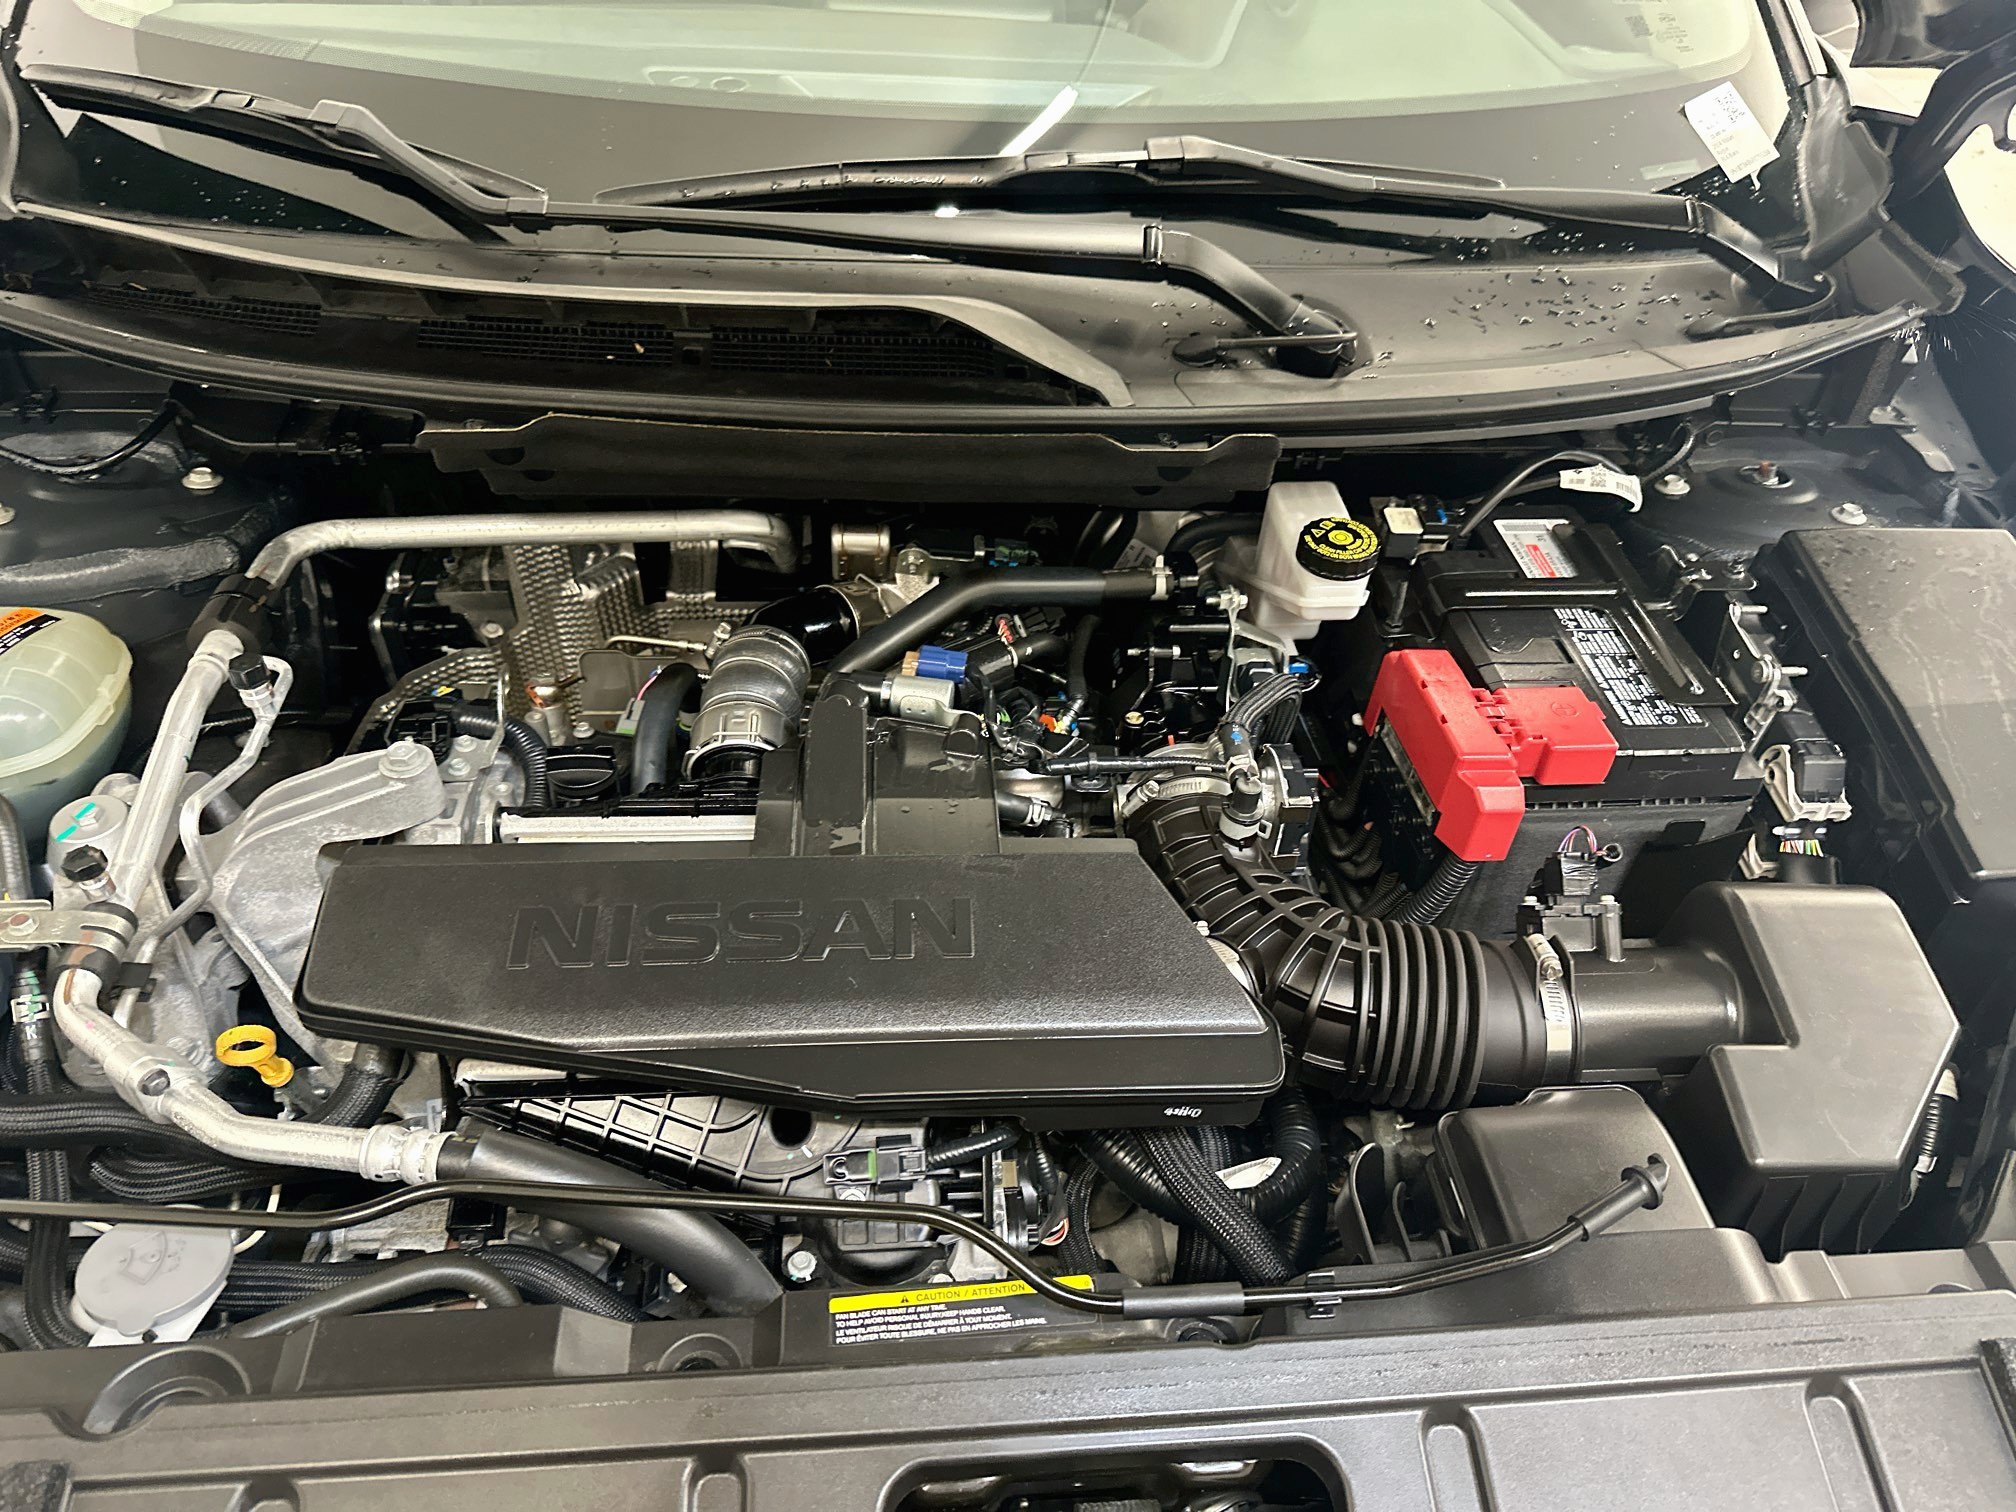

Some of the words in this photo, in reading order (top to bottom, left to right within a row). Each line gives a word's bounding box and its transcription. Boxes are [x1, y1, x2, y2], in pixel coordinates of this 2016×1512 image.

[506, 898, 975, 969] NISSAN
[25, 1025, 38, 1040] K
[916, 1291, 961, 1302] CAUTION
[971, 1284, 1026, 1297] ATTENTION
[846, 1319, 864, 1327] HELP
[864, 1317, 884, 1325] AVOID
[885, 1314, 919, 1323] PERSONAL
[959, 1307, 982, 1315] HANDS
[982, 1305, 1006, 1314] CLEAR.
[850, 1311, 871, 1319] BLADE
[887, 1307, 907, 1315] START
[930, 1303, 947, 1311] TIME.
[836, 1336, 856, 1344] POUR
[879, 1332, 901, 1340] TOUTE
[937, 1326, 947, 1334] NE
[947, 1325, 961, 1333] PAS
[971, 1321, 1012, 1331] APPROCHER
[1012, 1319, 1025, 1327] LES
[845, 1325, 887, 1335] VENTILATEUR
[887, 1323, 912, 1331] RISQUE
[913, 1321, 922, 1329] DE
